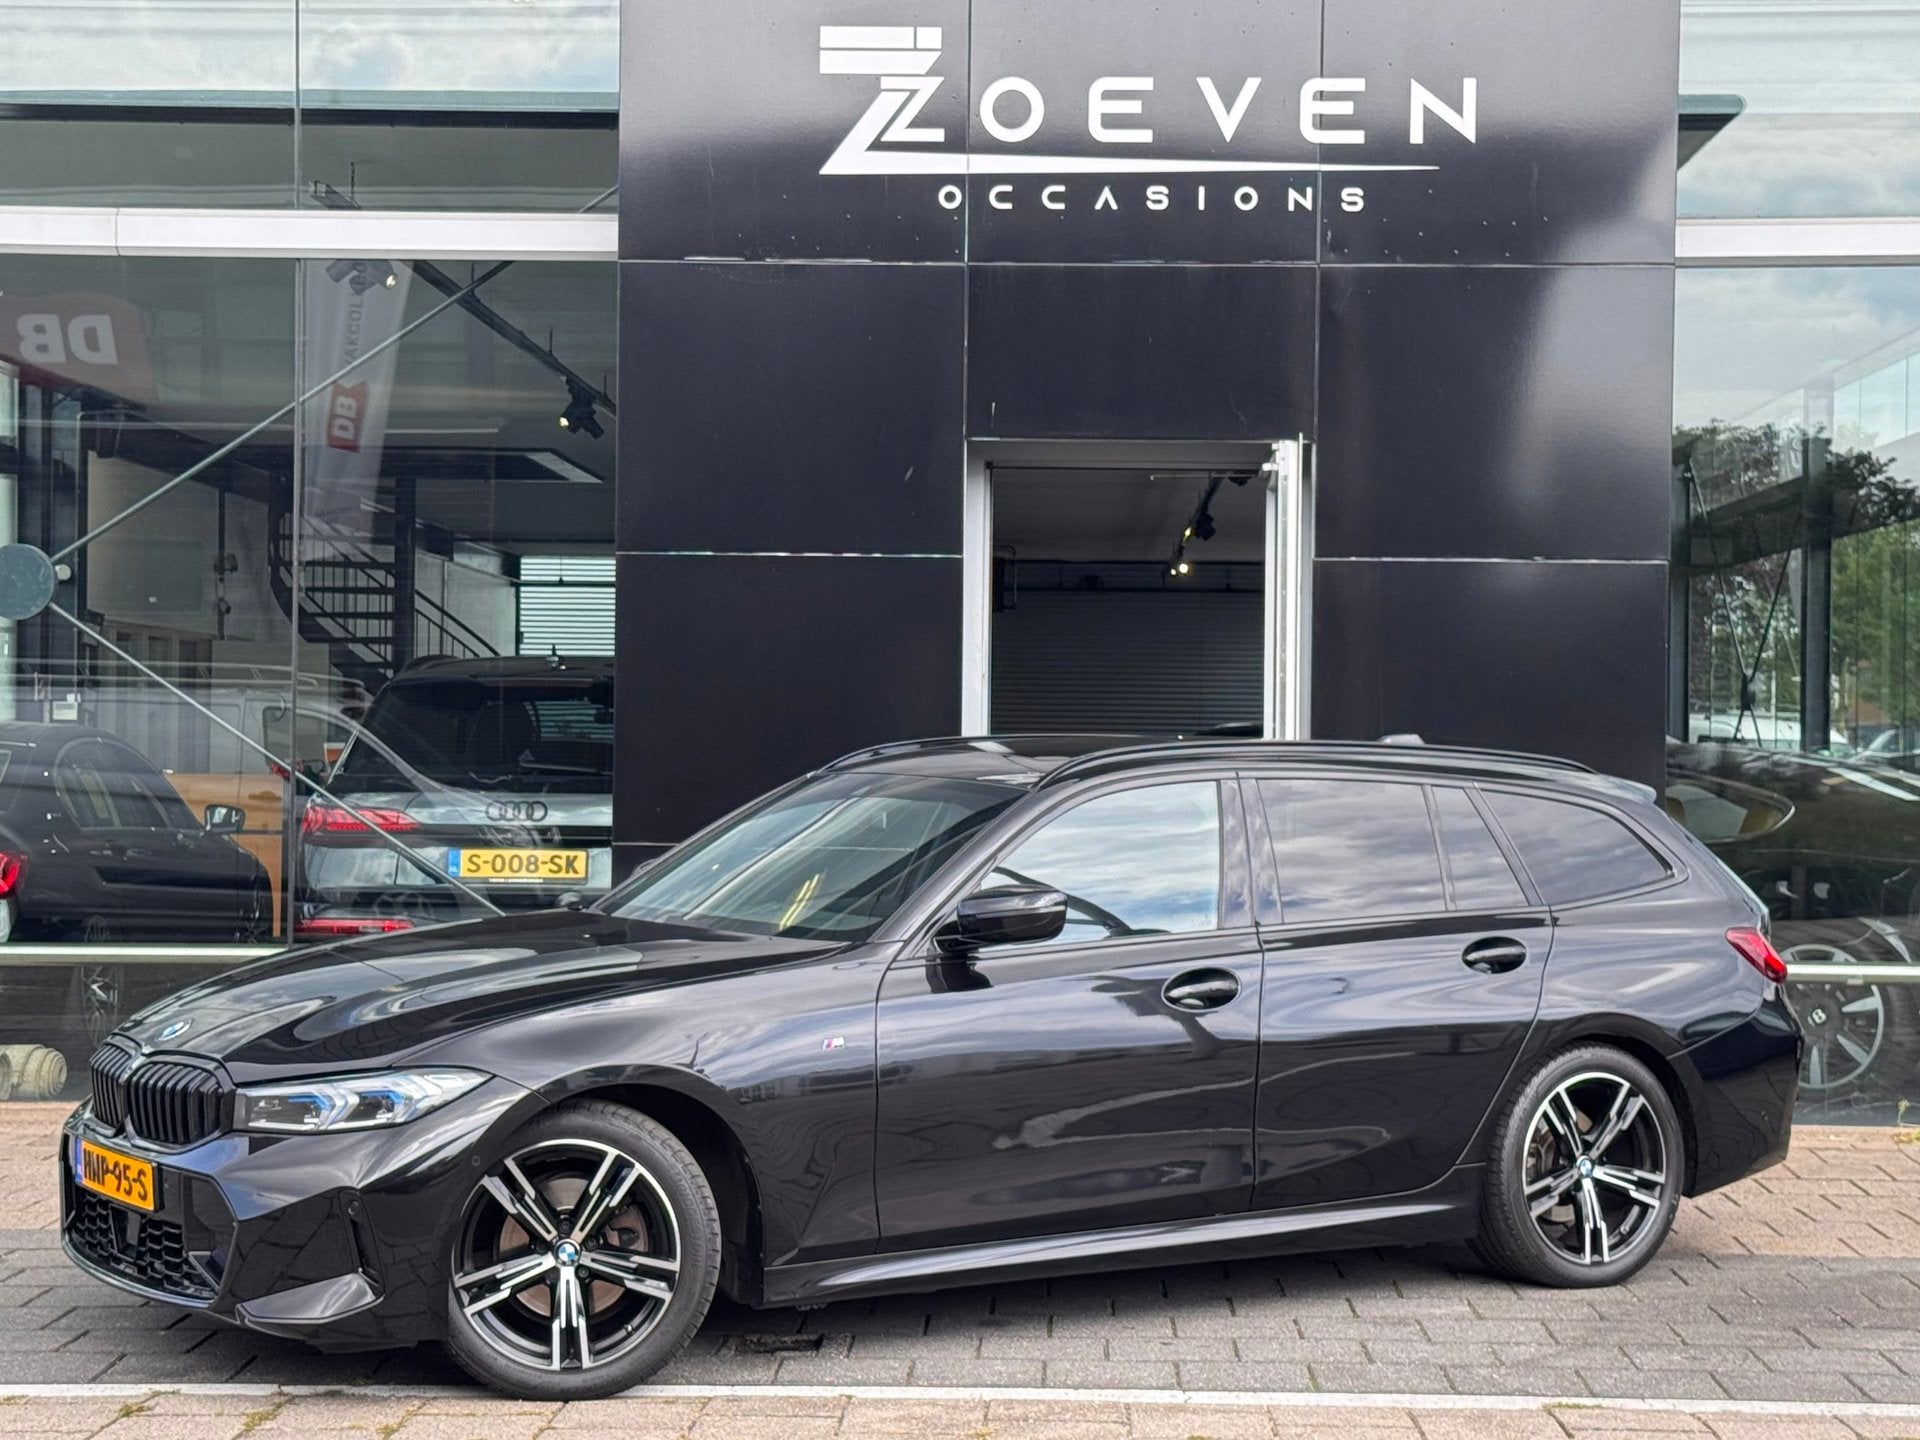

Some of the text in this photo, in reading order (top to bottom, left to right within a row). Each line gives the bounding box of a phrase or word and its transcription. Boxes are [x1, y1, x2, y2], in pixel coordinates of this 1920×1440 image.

[880, 76, 1477, 144] ZOEVEN
[938, 185, 1365, 212] OCCASIONS
[330, 395, 360, 441] DB
[466, 853, 580, 875] S-008-SK
